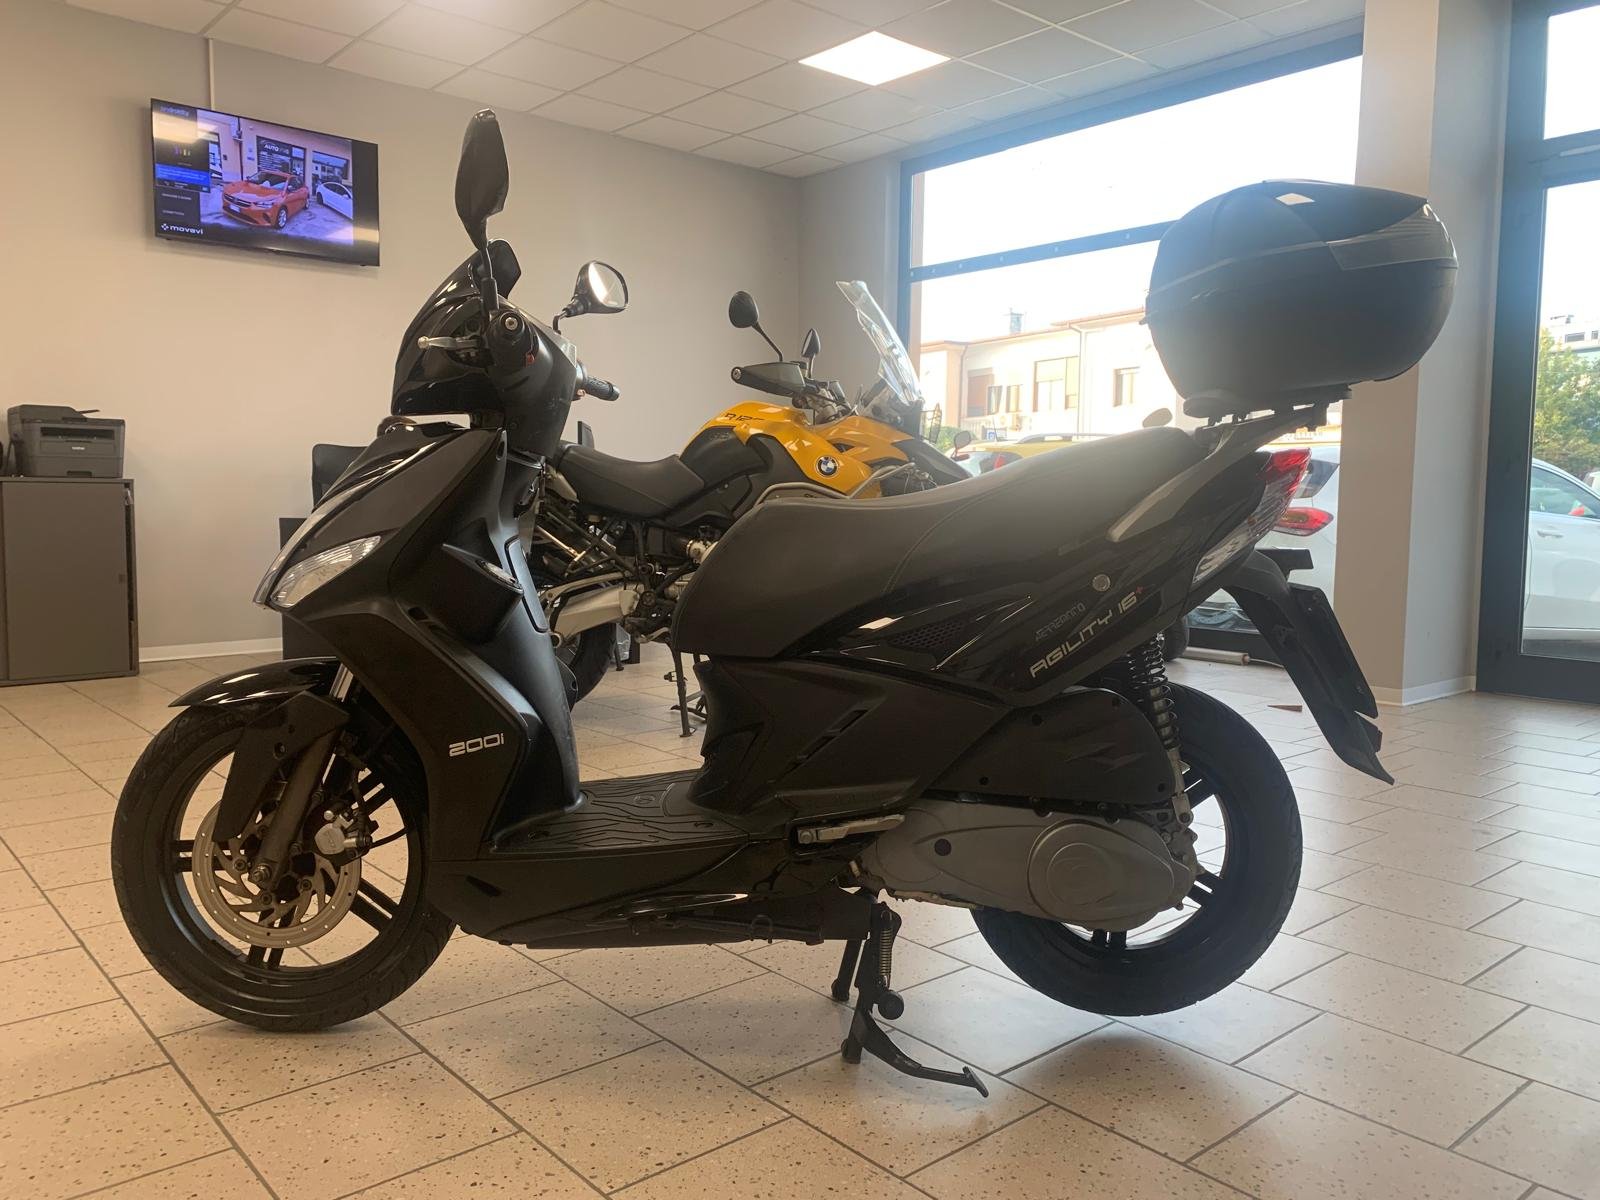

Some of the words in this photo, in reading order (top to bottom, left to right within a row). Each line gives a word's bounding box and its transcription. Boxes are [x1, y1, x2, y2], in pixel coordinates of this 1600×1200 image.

[170, 225, 203, 235] movavi
[1029, 609, 1113, 679] AGILITY
[448, 732, 505, 757] 200i
